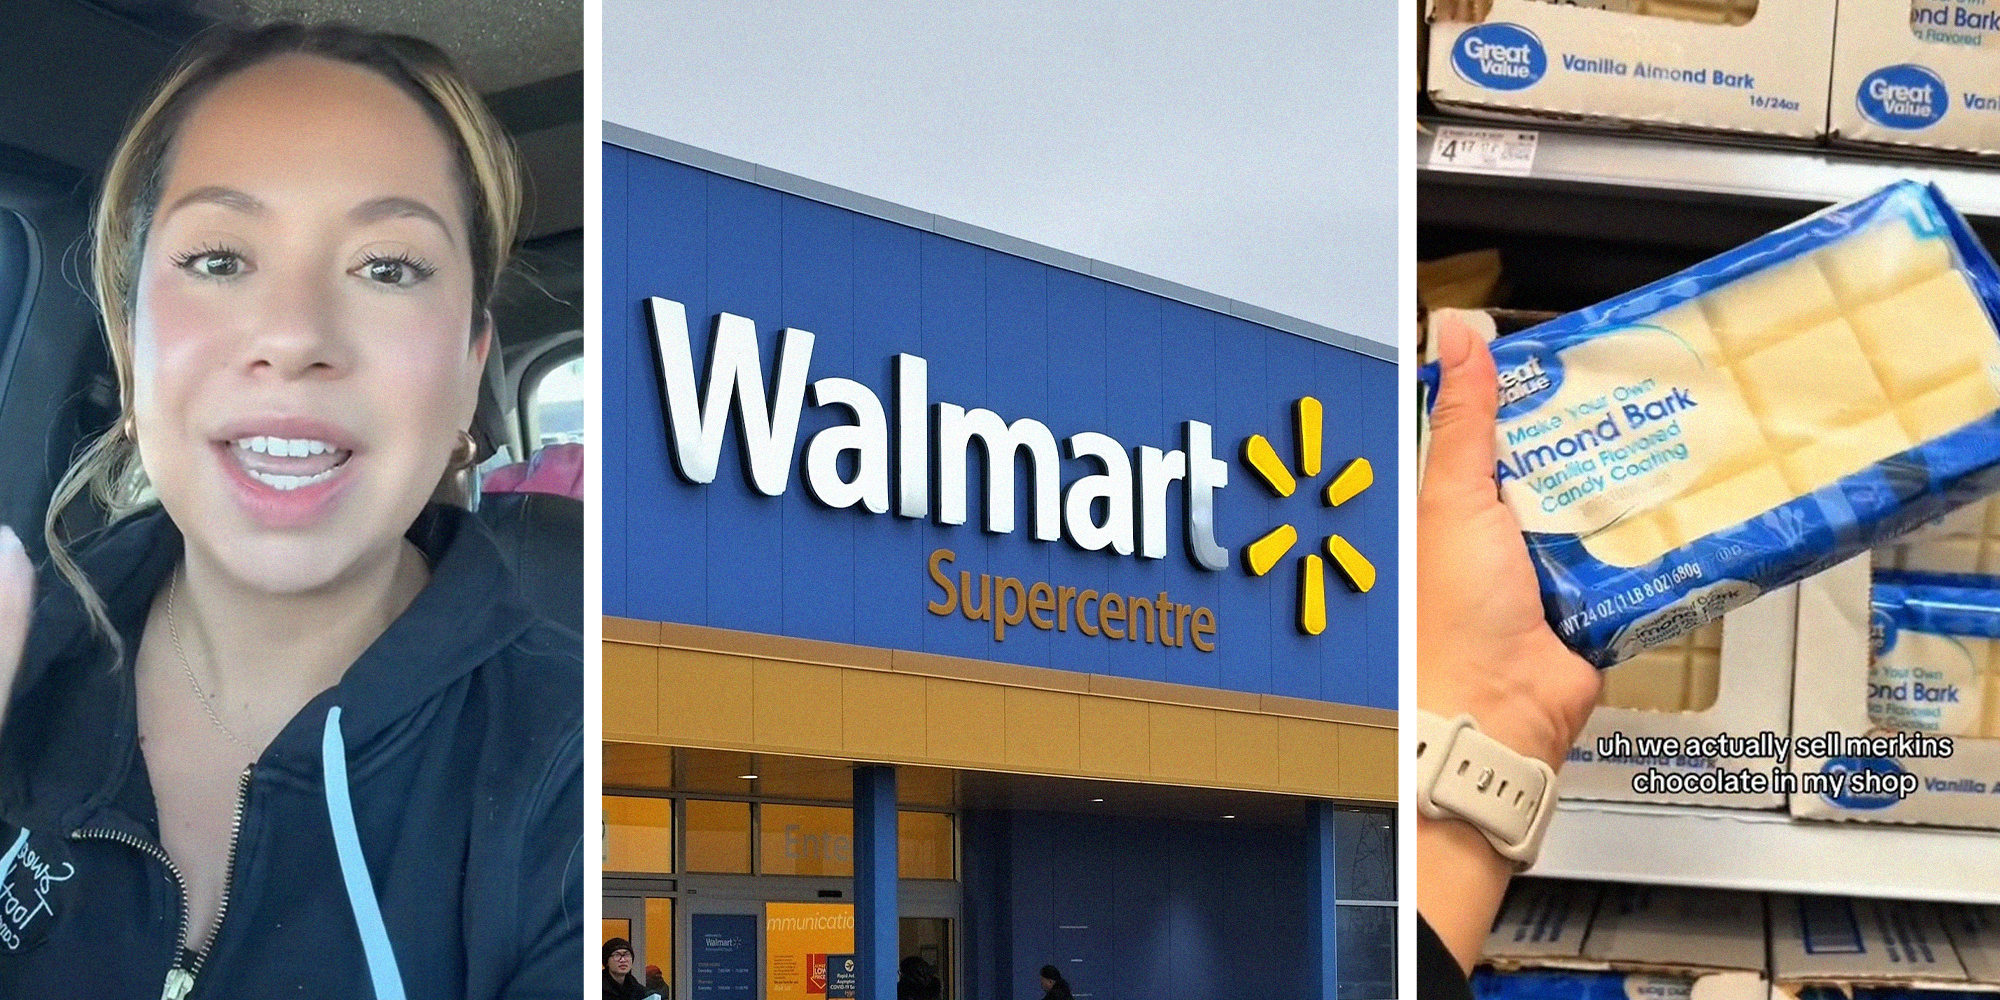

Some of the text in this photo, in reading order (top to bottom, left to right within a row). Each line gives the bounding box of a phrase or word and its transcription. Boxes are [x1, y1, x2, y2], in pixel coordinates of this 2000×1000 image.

[1954, 6, 2000, 31] Bark
[1464, 36, 1531, 65] Great
[1480, 58, 1530, 79] Value
[1562, 53, 1755, 89] Vanilla Almond Bark
[1749, 94, 1800, 111] 16/24oz
[1869, 78, 1933, 104] Great
[1883, 100, 1931, 118] Value
[1506, 377, 1656, 447] Make Your Own
[645, 296, 1229, 571] Walmart
[1496, 386, 1698, 486] Almond Bark
[1528, 419, 1682, 494] Vanilla Flavored
[1541, 474, 1606, 513] Candy
[1610, 442, 1689, 482] Coating
[928, 548, 1217, 652] Supercentre
[1580, 607, 1599, 628] 24
[1597, 598, 1616, 619] OZ
[1629, 586, 1645, 606] LB
[1644, 582, 1655, 599] 8
[1672, 560, 1703, 584] 680g
[1913, 681, 1959, 703] Bark
[1924, 776, 1986, 794] Vanilla
[705, 937, 733, 947] Walmart
